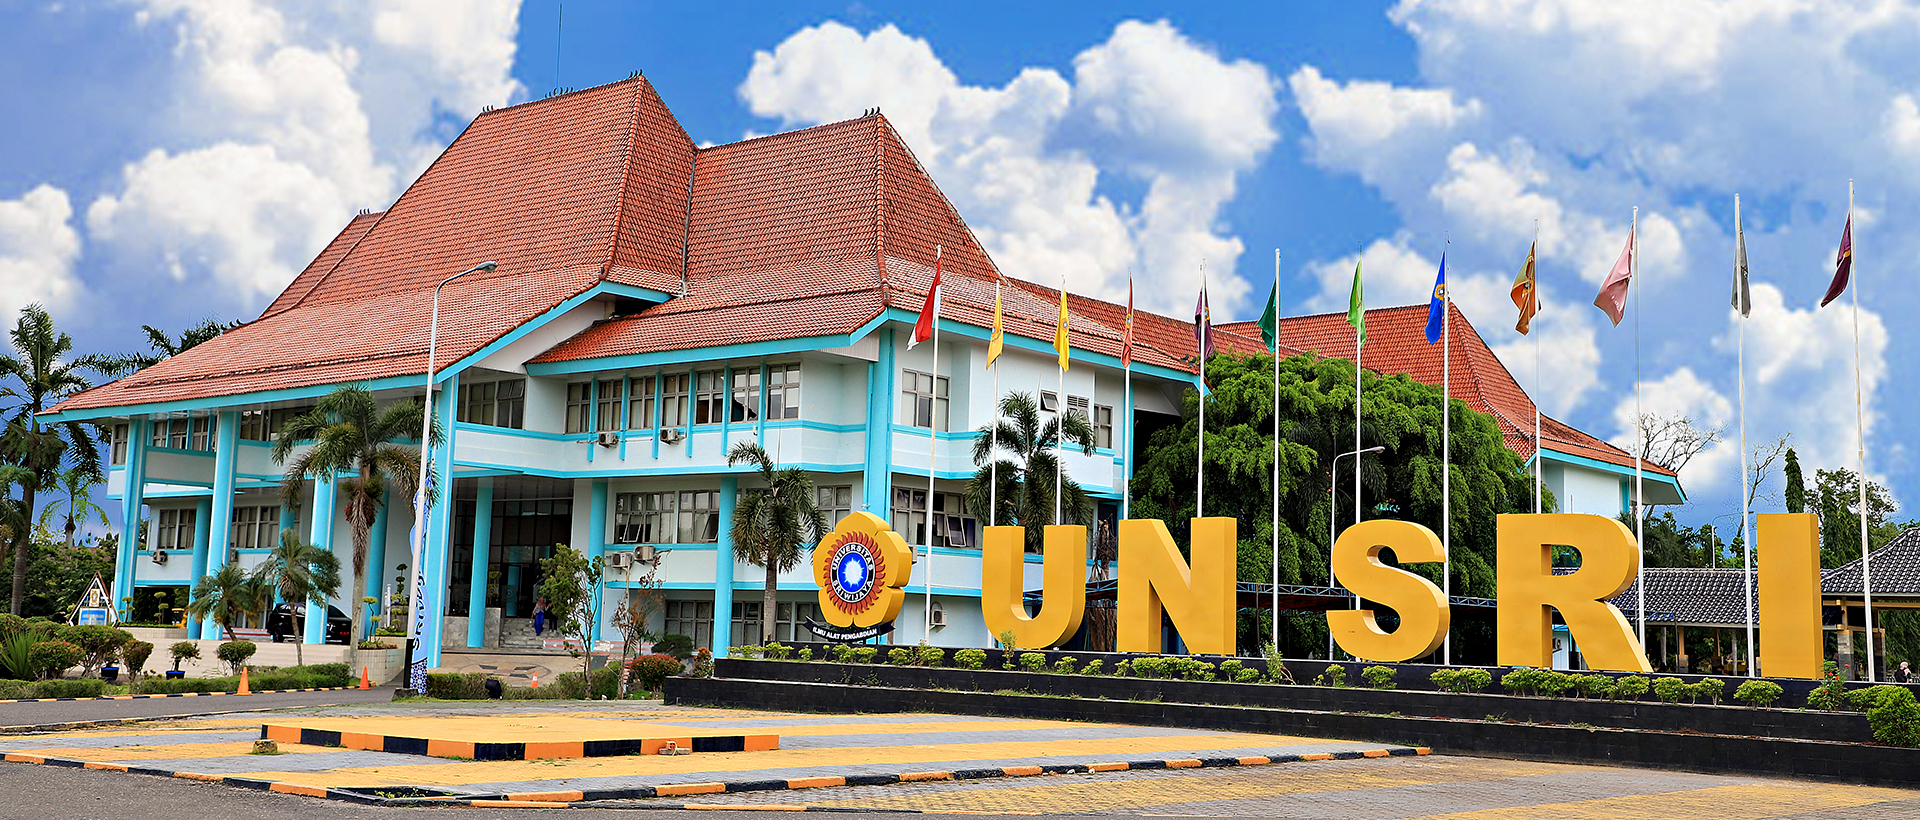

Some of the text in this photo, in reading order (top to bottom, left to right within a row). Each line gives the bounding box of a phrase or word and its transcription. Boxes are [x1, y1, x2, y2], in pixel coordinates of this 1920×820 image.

[832, 544, 874, 570] UNIVERSITAS
[833, 580, 872, 601] SRIWIJAYA
[813, 626, 826, 636] ILMU
[841, 628, 877, 640] PENGABDIAN
